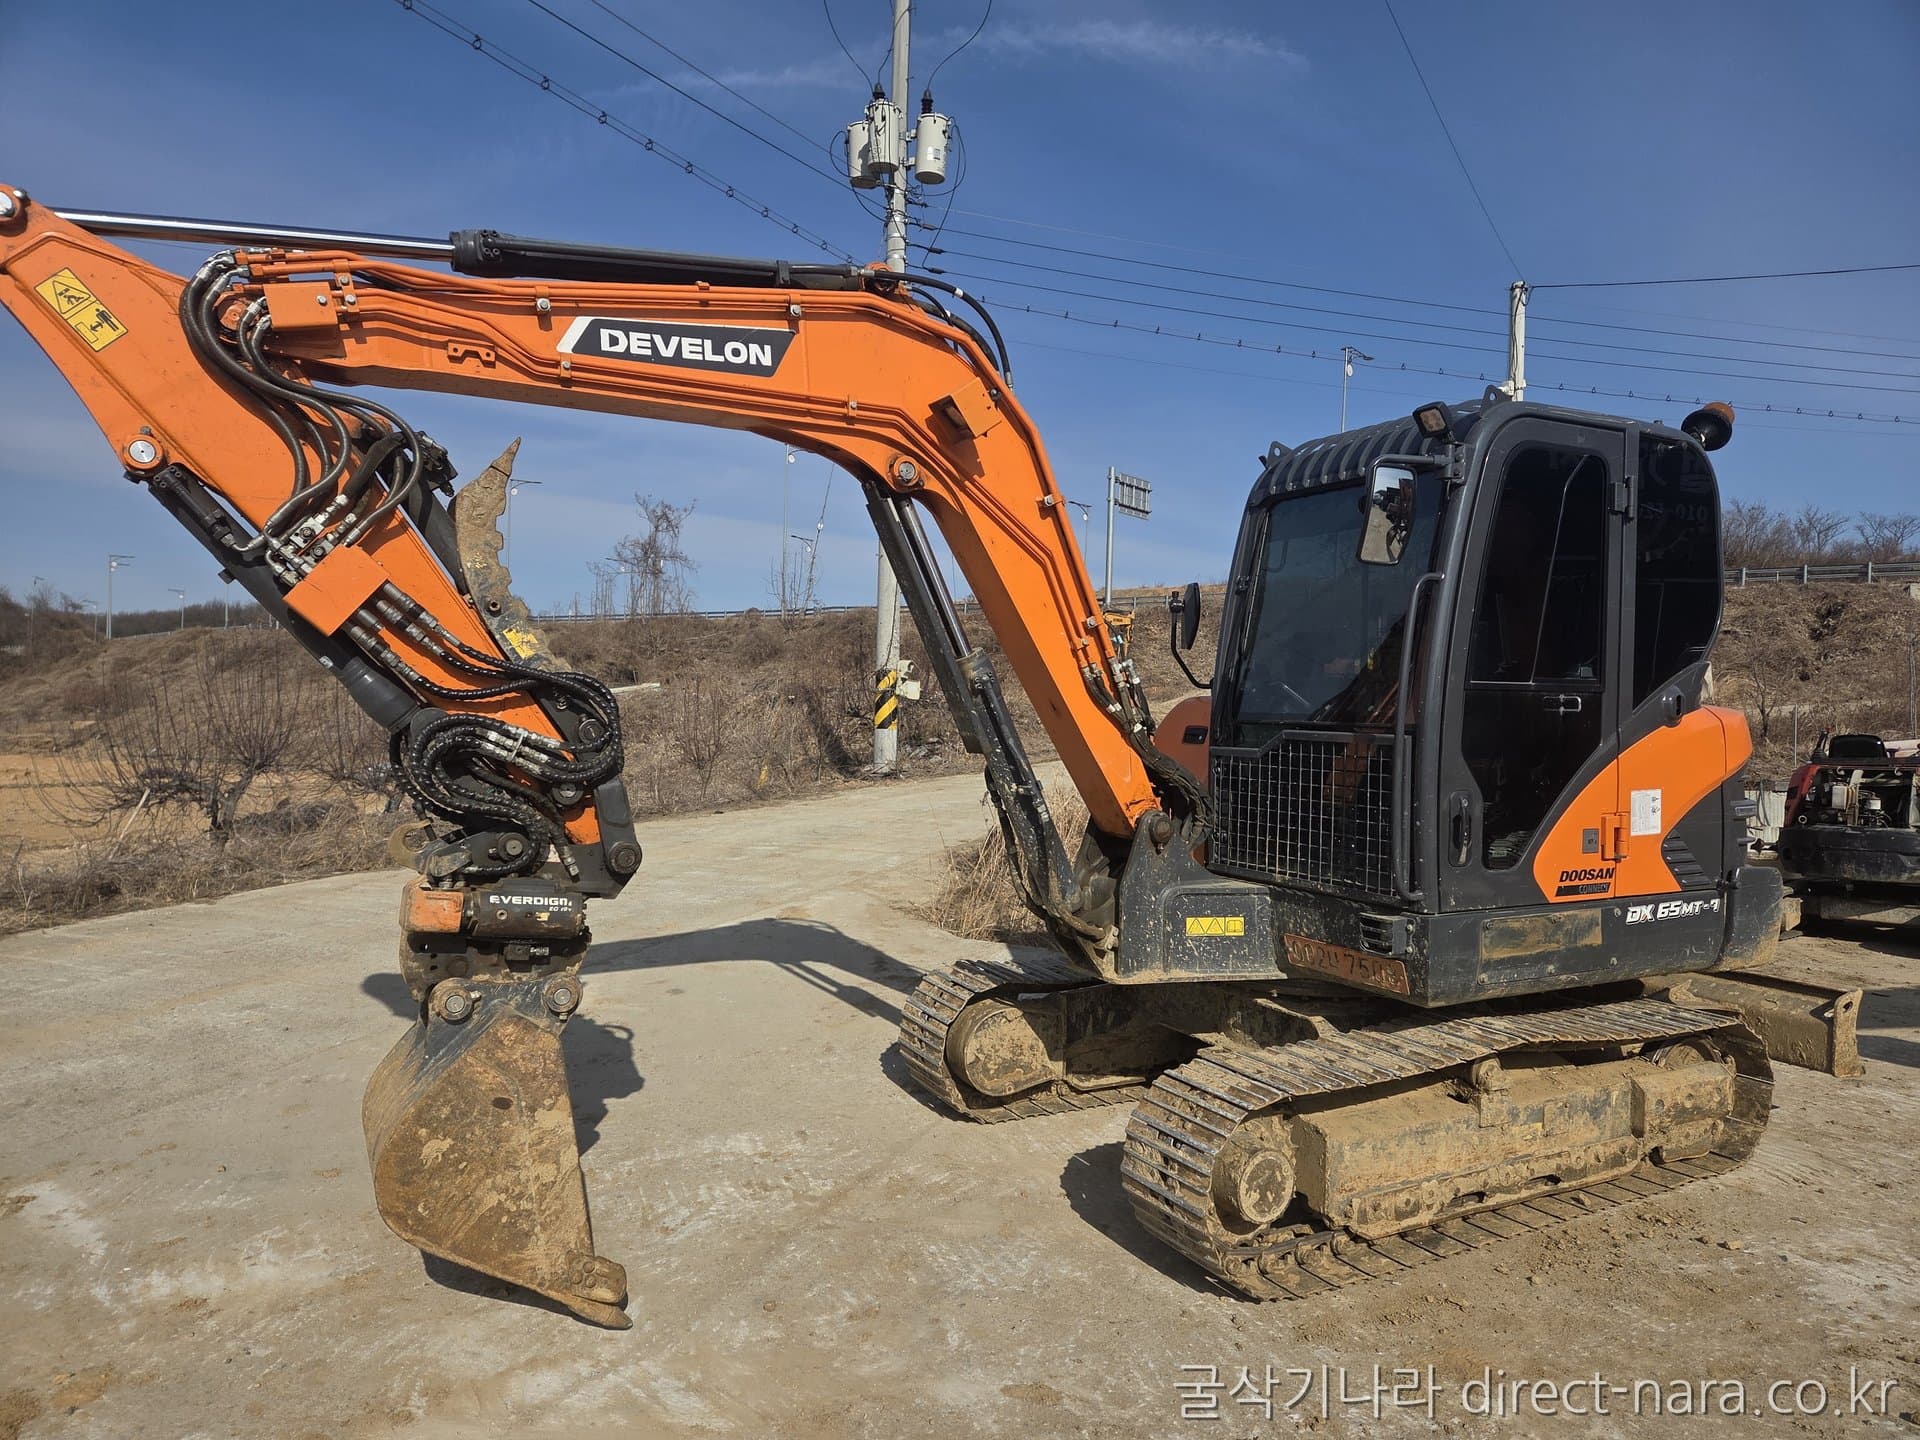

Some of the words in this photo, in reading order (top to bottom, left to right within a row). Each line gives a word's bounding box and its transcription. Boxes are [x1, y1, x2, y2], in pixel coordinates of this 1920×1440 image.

[599, 328, 772, 367] DEVELON
[1559, 867, 1615, 882] DOOSAN
[1625, 904, 1655, 925] DX
